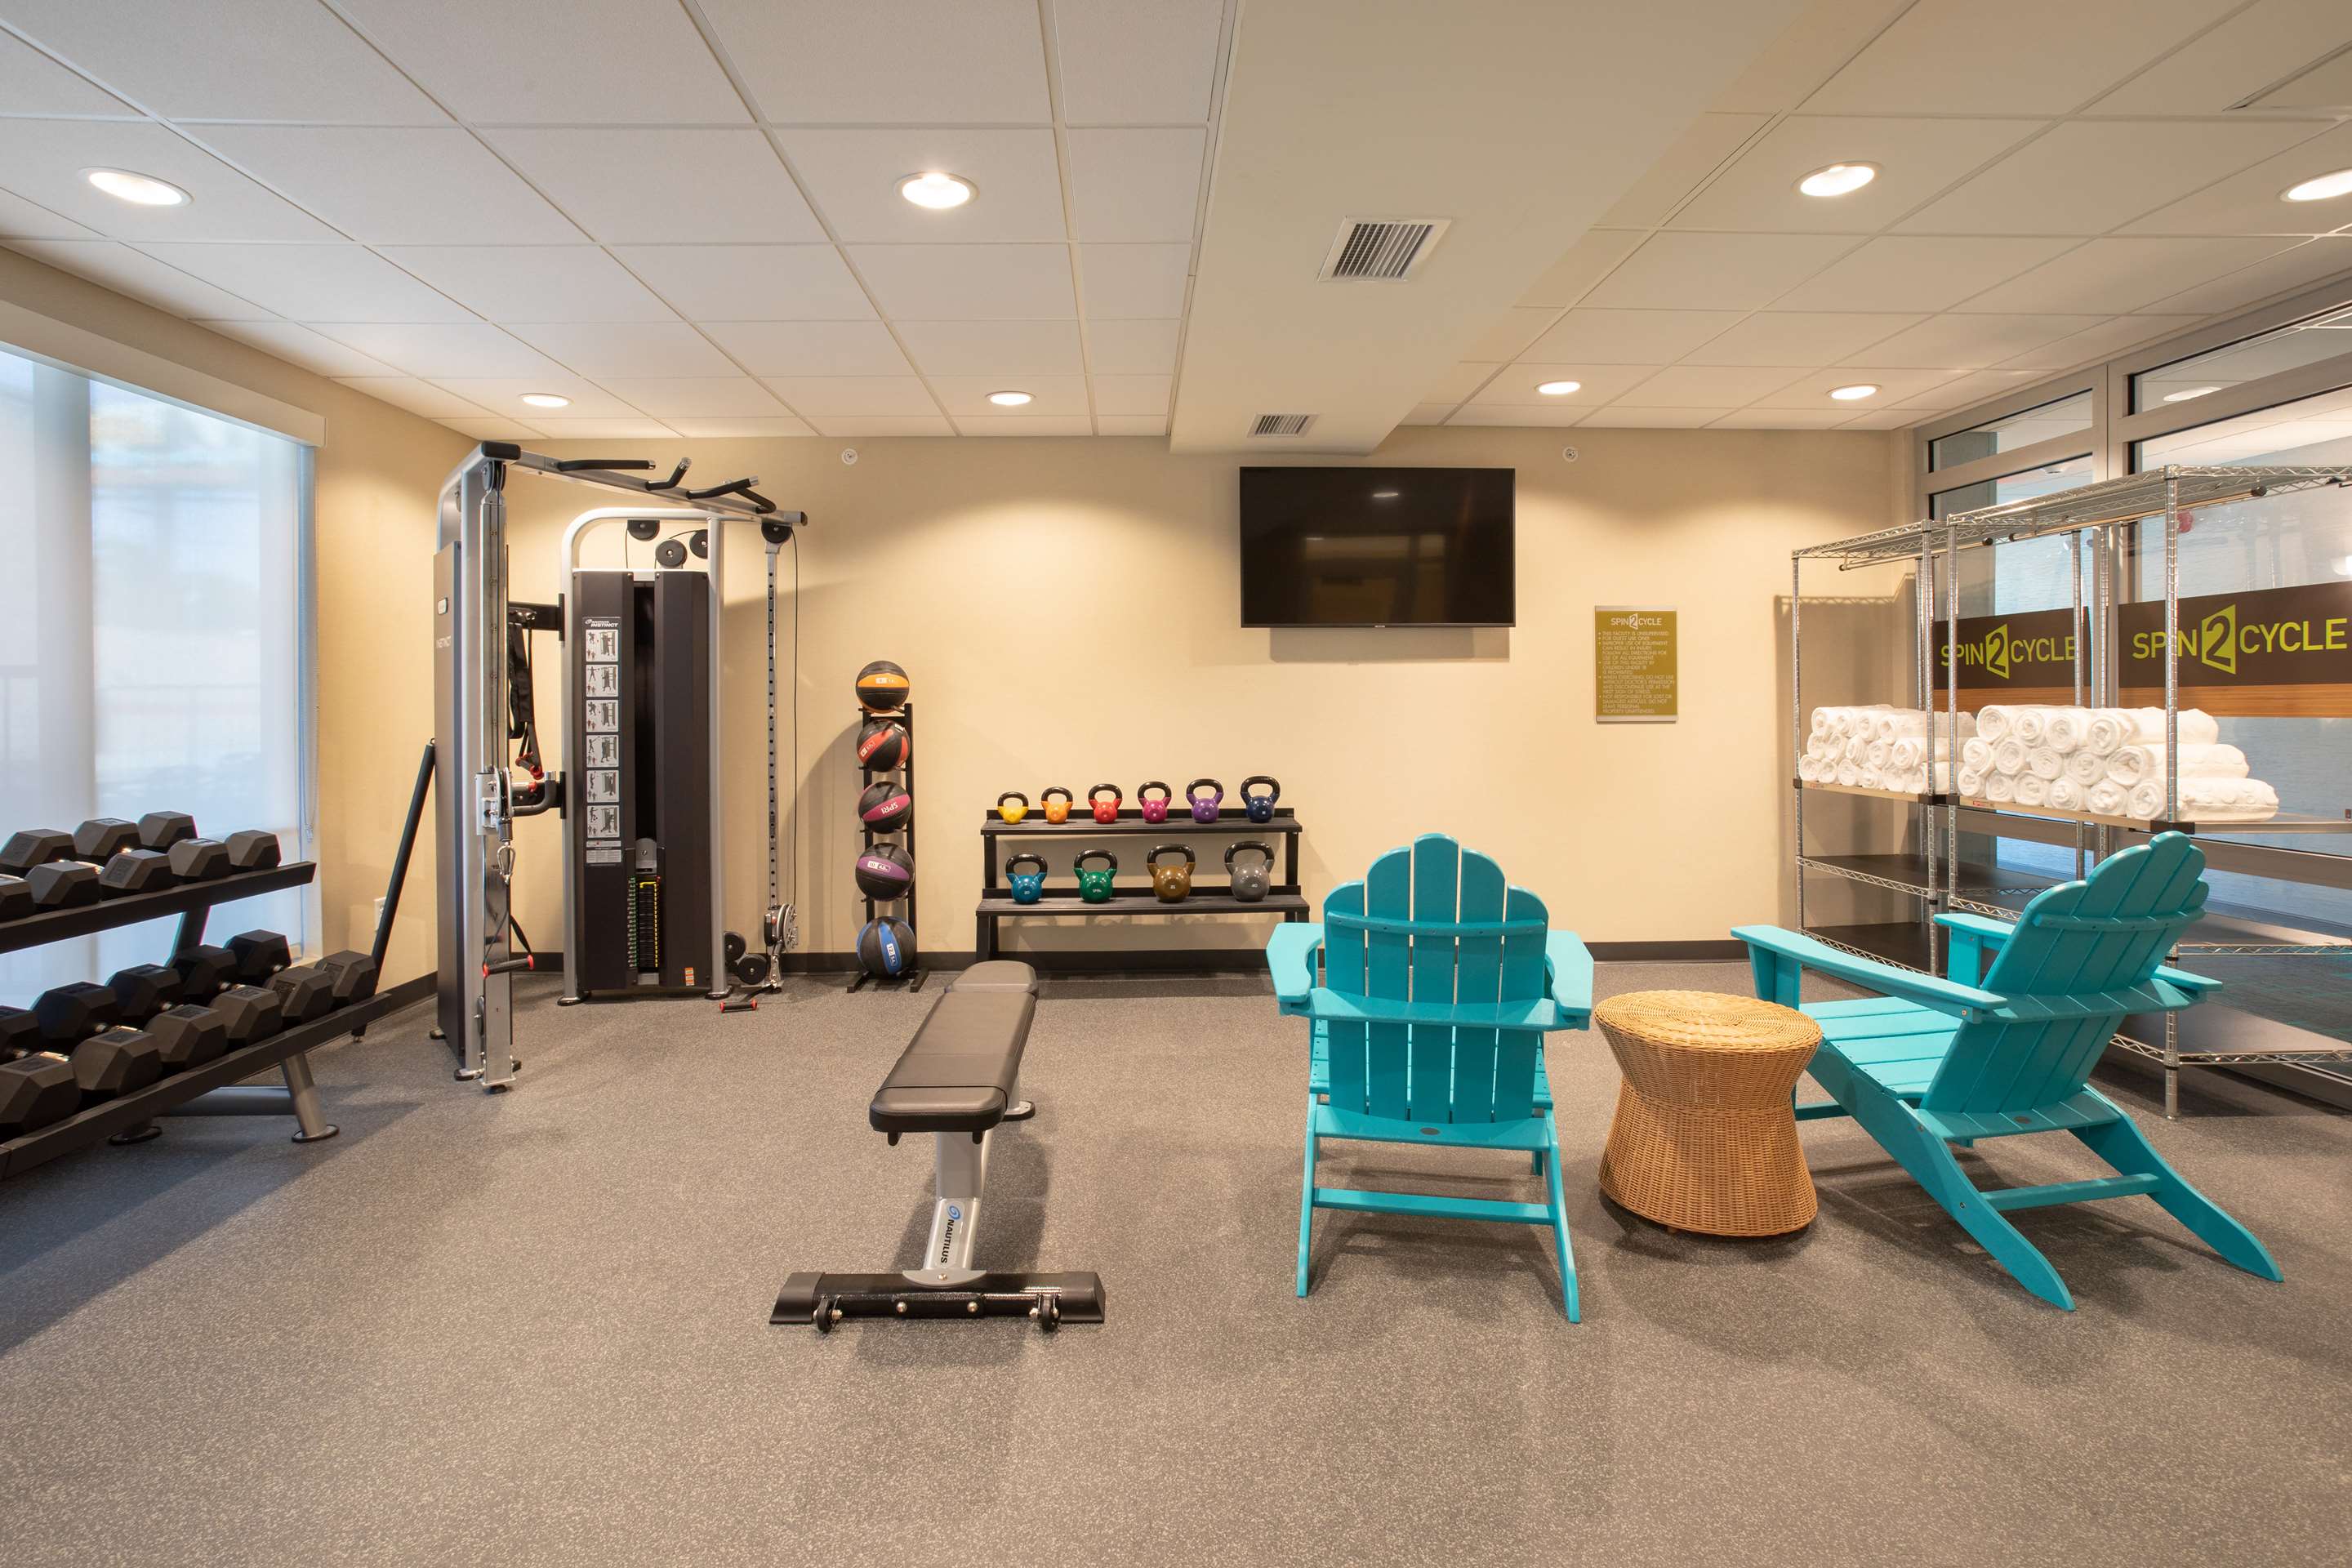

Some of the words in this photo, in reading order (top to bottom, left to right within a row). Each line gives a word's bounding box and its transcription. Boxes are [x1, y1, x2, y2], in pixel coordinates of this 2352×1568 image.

[2132, 629, 2198, 659] SPN
[2240, 618, 2348, 654] CYCLE
[881, 802, 898, 814] SPRI
[941, 1219, 955, 1263] NAUTILUS
